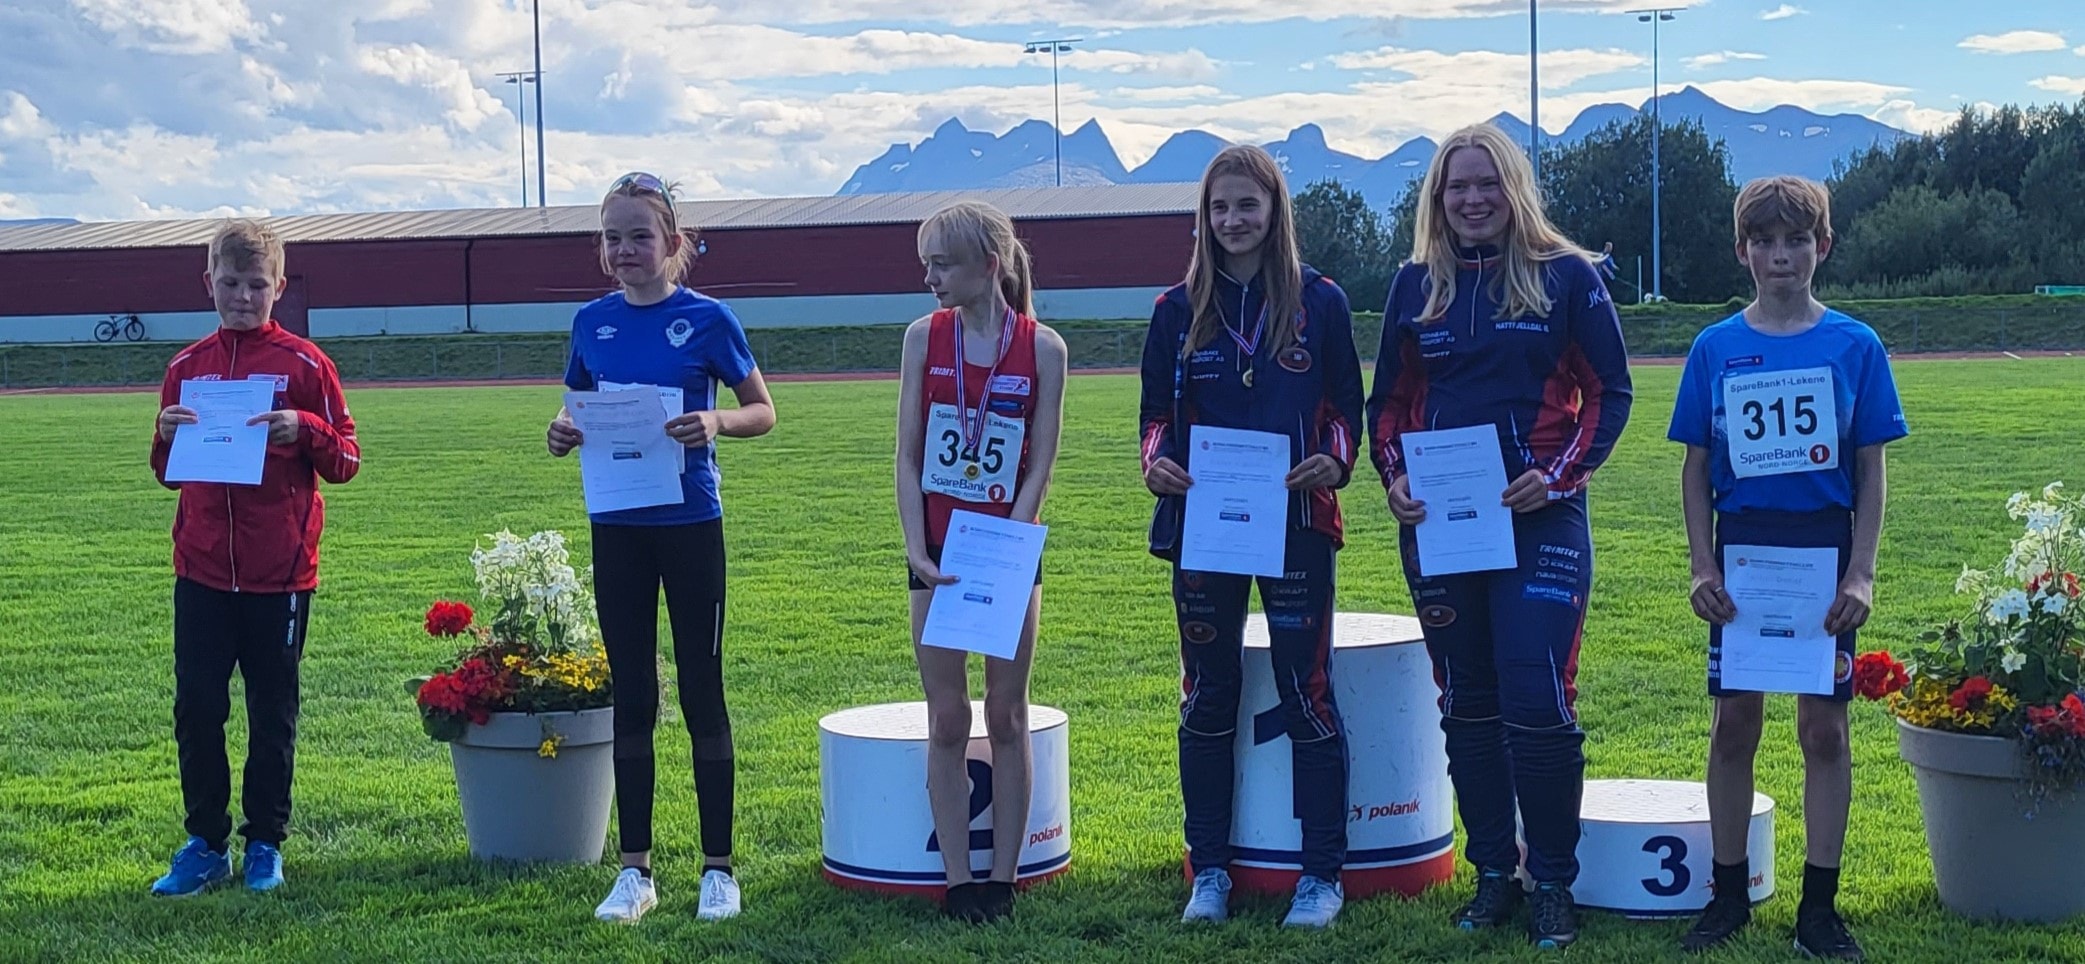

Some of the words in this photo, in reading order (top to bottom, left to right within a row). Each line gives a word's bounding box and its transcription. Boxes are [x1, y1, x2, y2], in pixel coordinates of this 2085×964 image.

[1730, 375, 1826, 393] SpareBank1-Lekene
[1742, 395, 1818, 441] 315
[938, 429, 1006, 475] 345
[1740, 446, 1807, 466] SpareBank
[930, 473, 987, 493] SpareBank
[1368, 799, 1421, 821] polanik
[1029, 822, 1064, 848] polanik
[1641, 835, 1691, 897] 3
